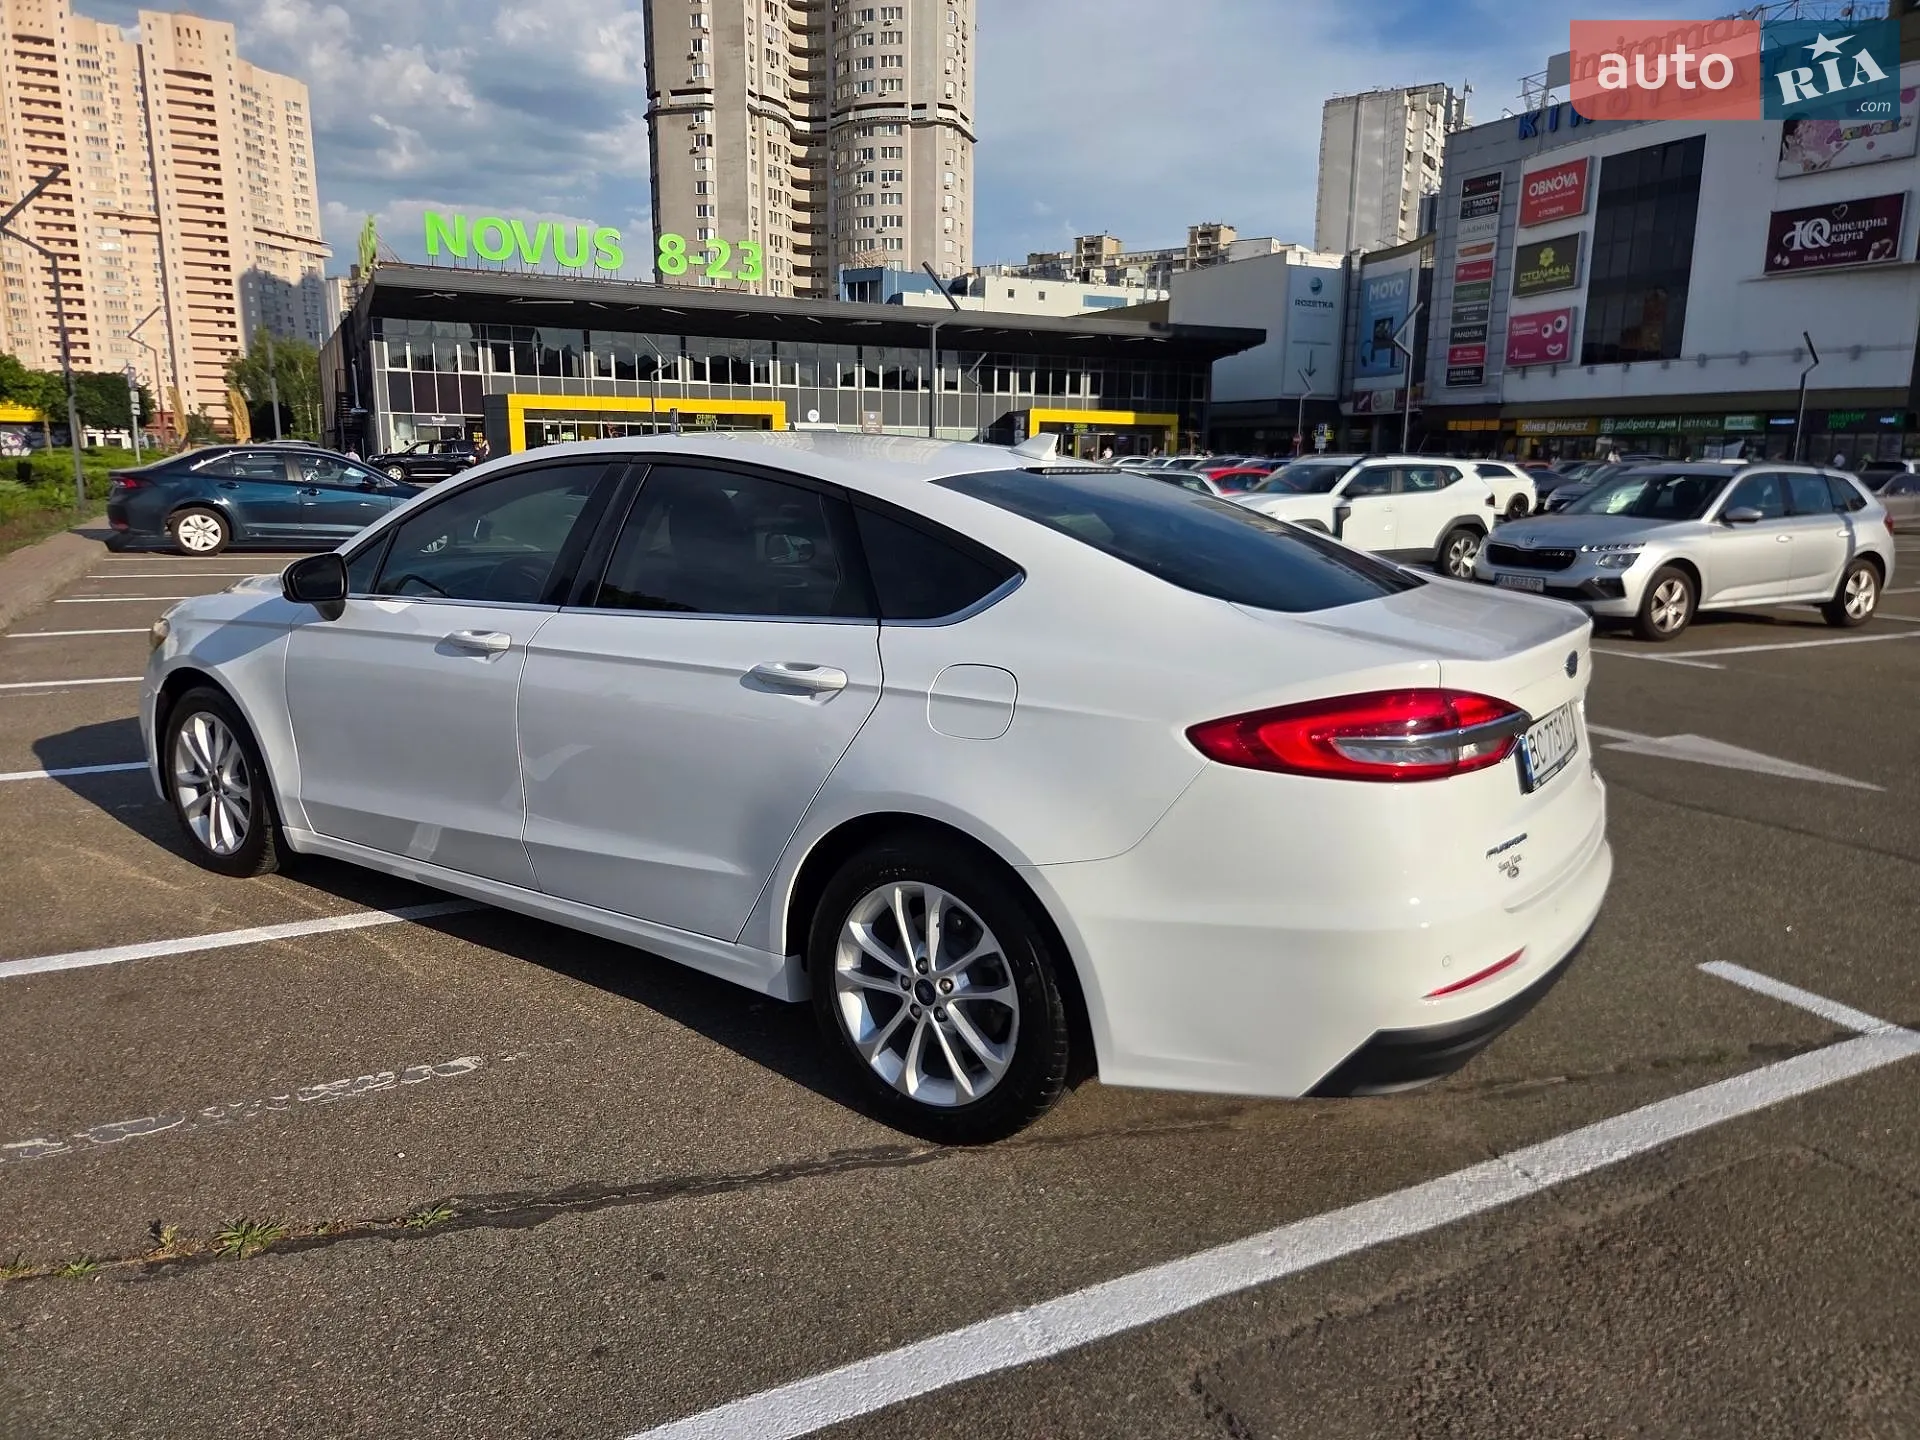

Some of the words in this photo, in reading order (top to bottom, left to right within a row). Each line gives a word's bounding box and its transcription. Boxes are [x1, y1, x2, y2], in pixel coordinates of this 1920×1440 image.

[424, 211, 624, 271] NOVUS
[658, 233, 763, 282] 8-23
[1369, 279, 1404, 301] MOYO
[1294, 299, 1334, 309] ROZETKA
